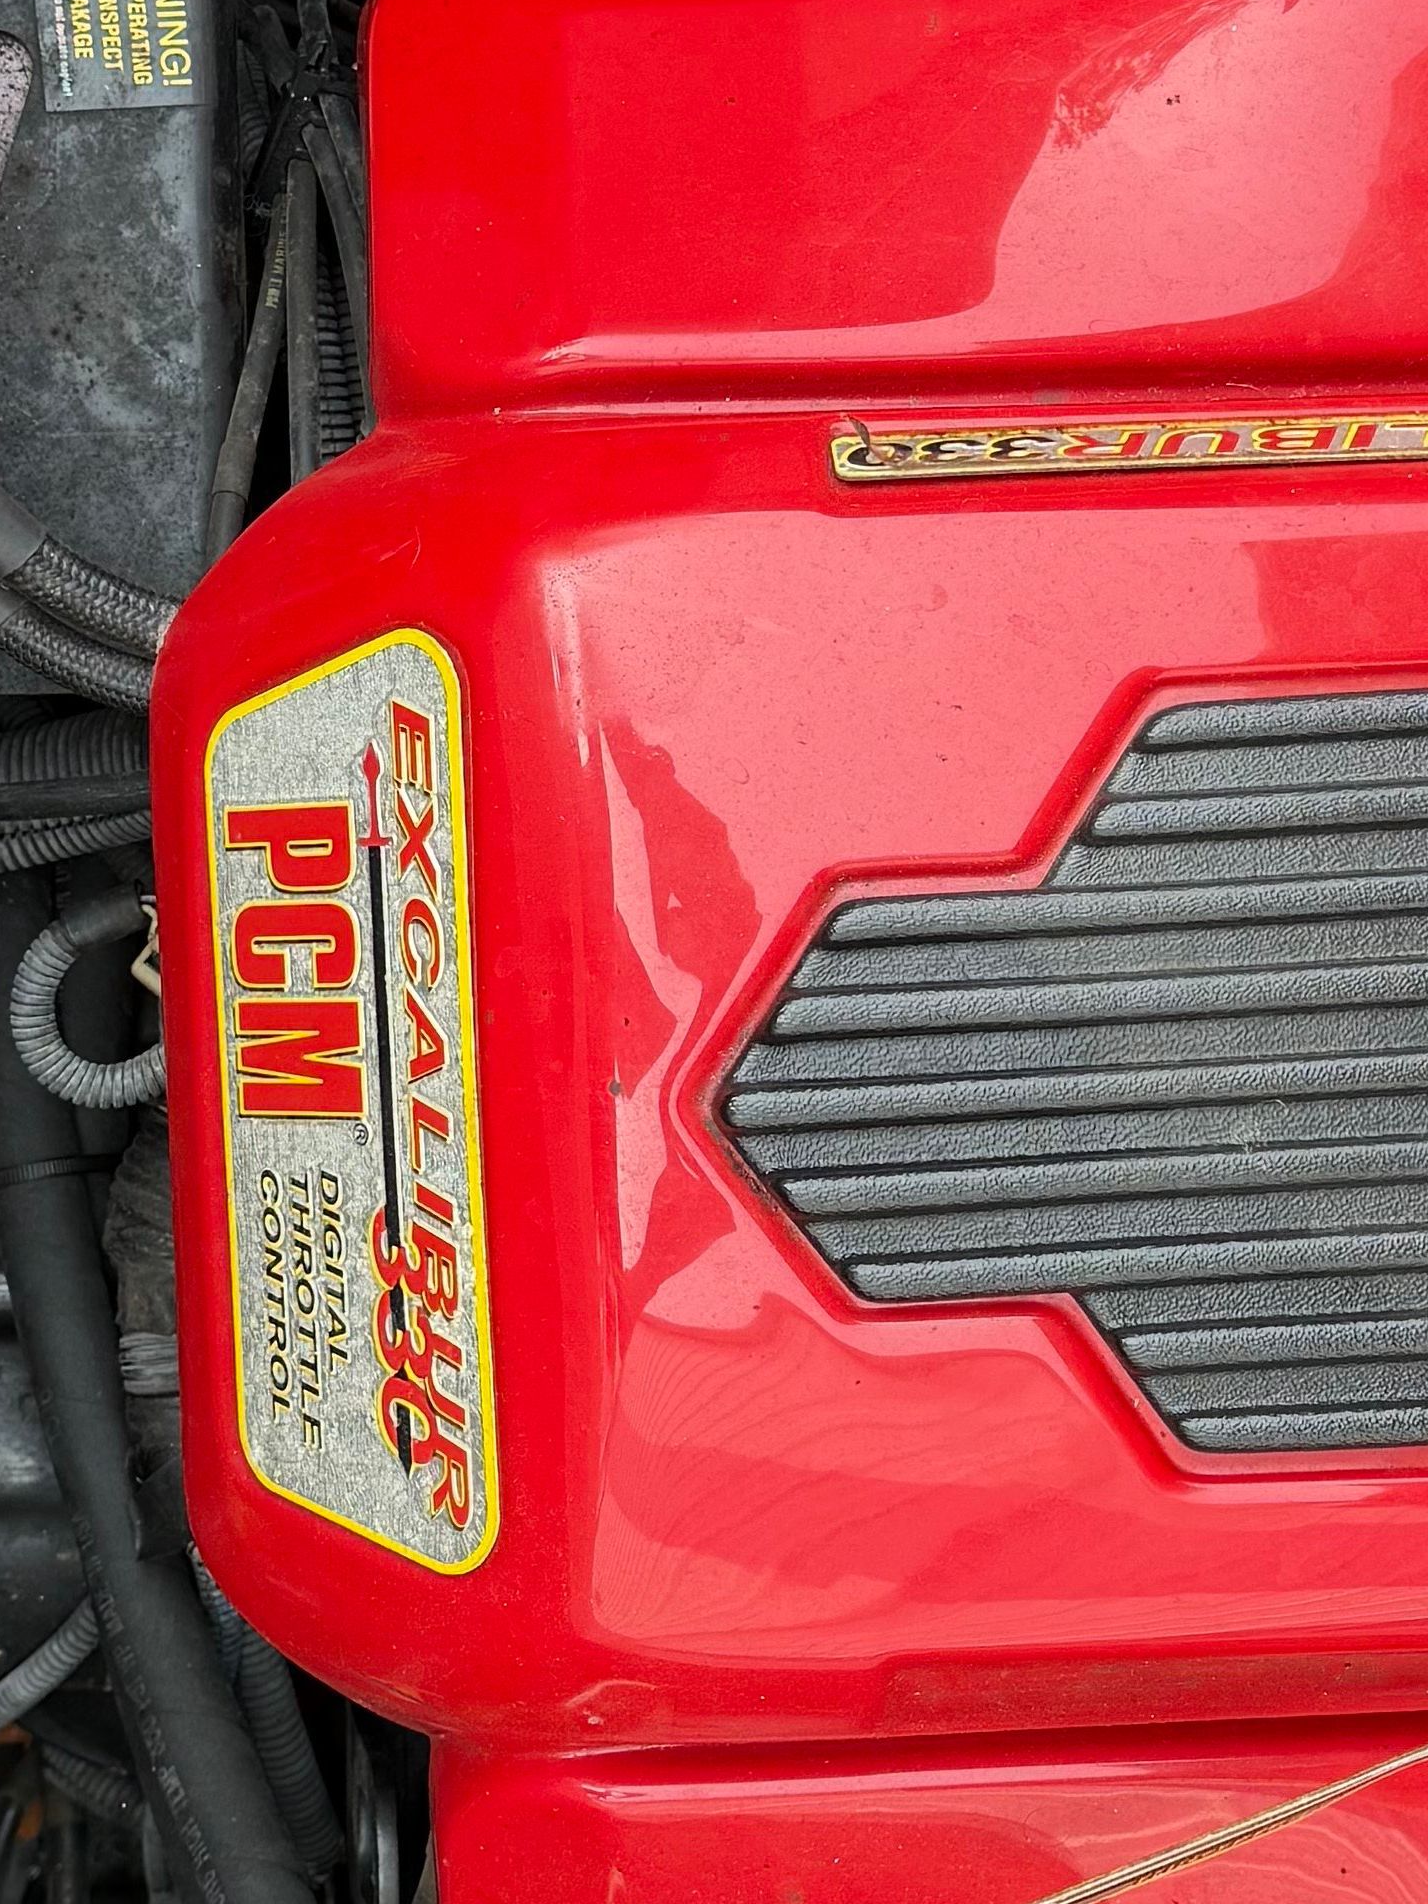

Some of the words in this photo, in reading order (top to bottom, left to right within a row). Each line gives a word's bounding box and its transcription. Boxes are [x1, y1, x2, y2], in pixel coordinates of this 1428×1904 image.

[223, 800, 368, 1121] PCM
[389, 698, 474, 1532] EXCALIBUR
[259, 1168, 290, 1422] CONTROL
[288, 1169, 324, 1452] THROTTLE
[318, 1168, 349, 1377] DIGITAL
[369, 1203, 436, 1470] 330
